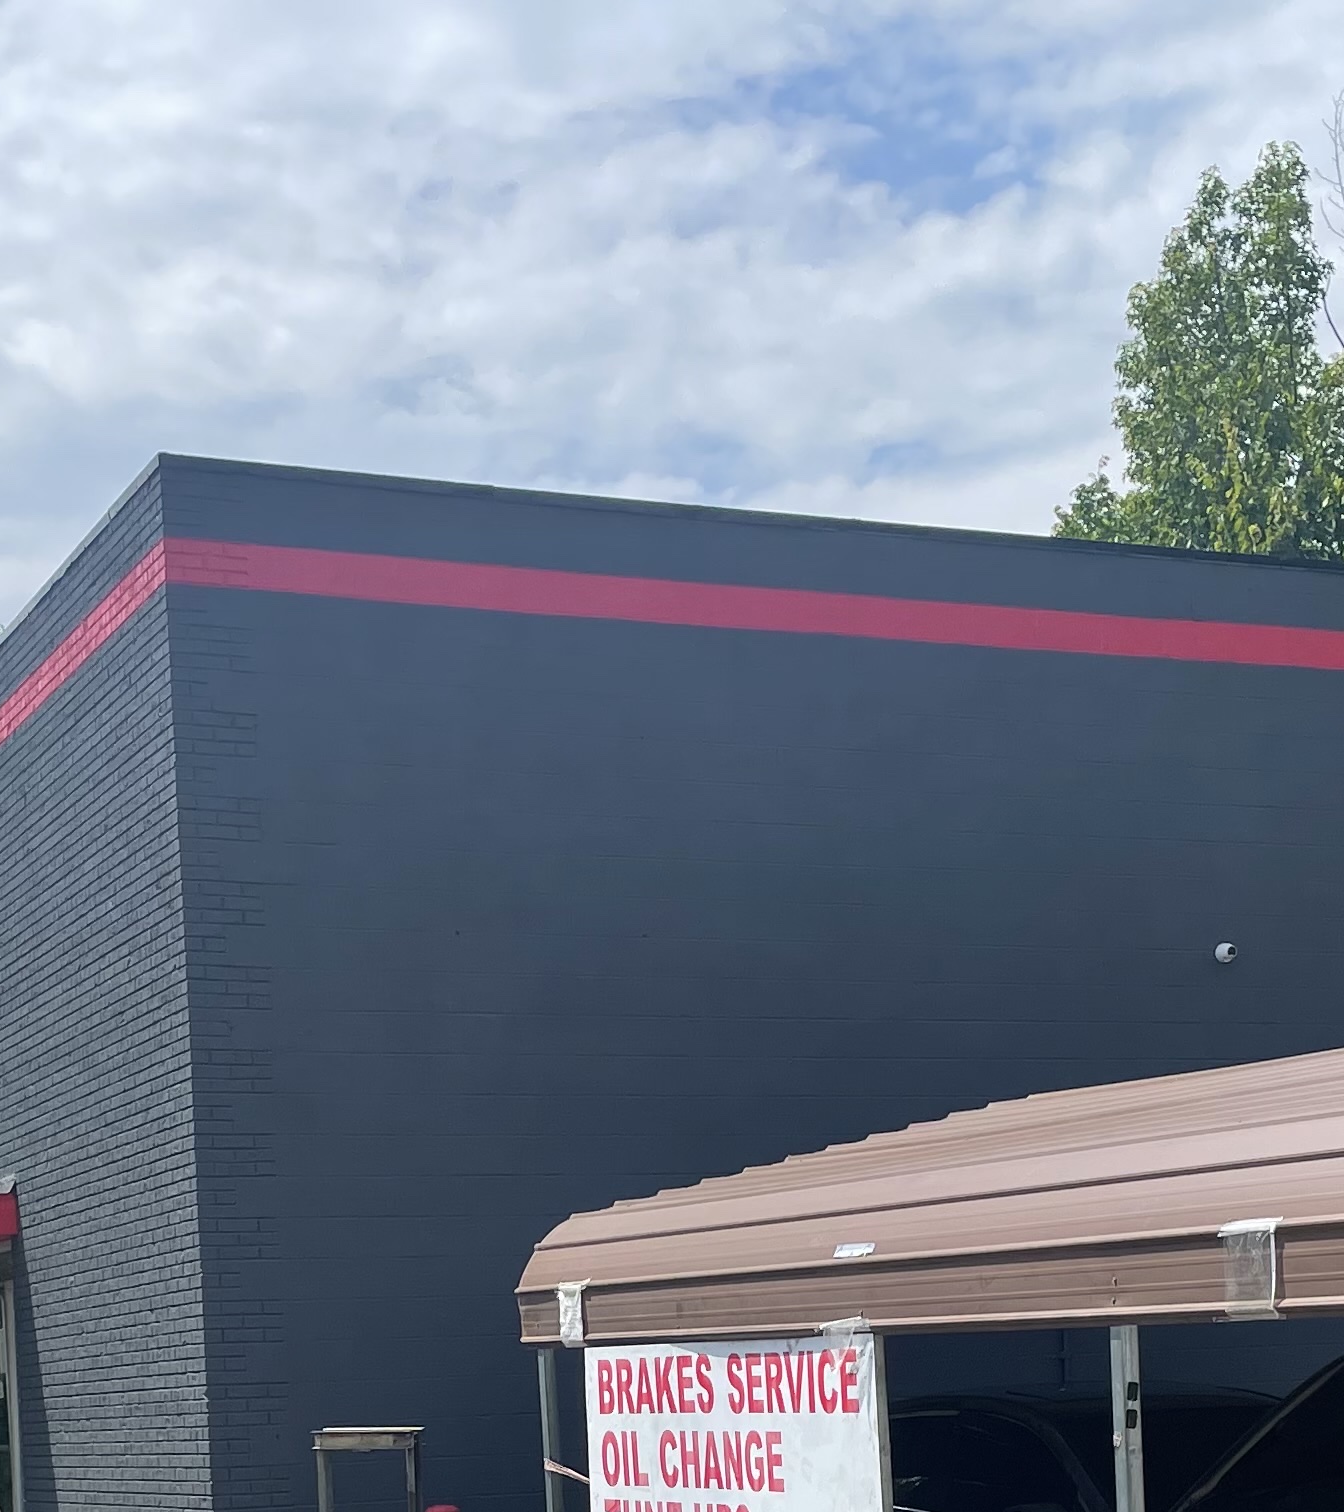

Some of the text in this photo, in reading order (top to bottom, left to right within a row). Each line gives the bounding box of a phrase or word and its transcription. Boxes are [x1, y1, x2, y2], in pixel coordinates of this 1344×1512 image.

[597, 1348, 860, 1415] BRAKES SERVICE
[602, 1430, 785, 1493] OIL CHANGE
